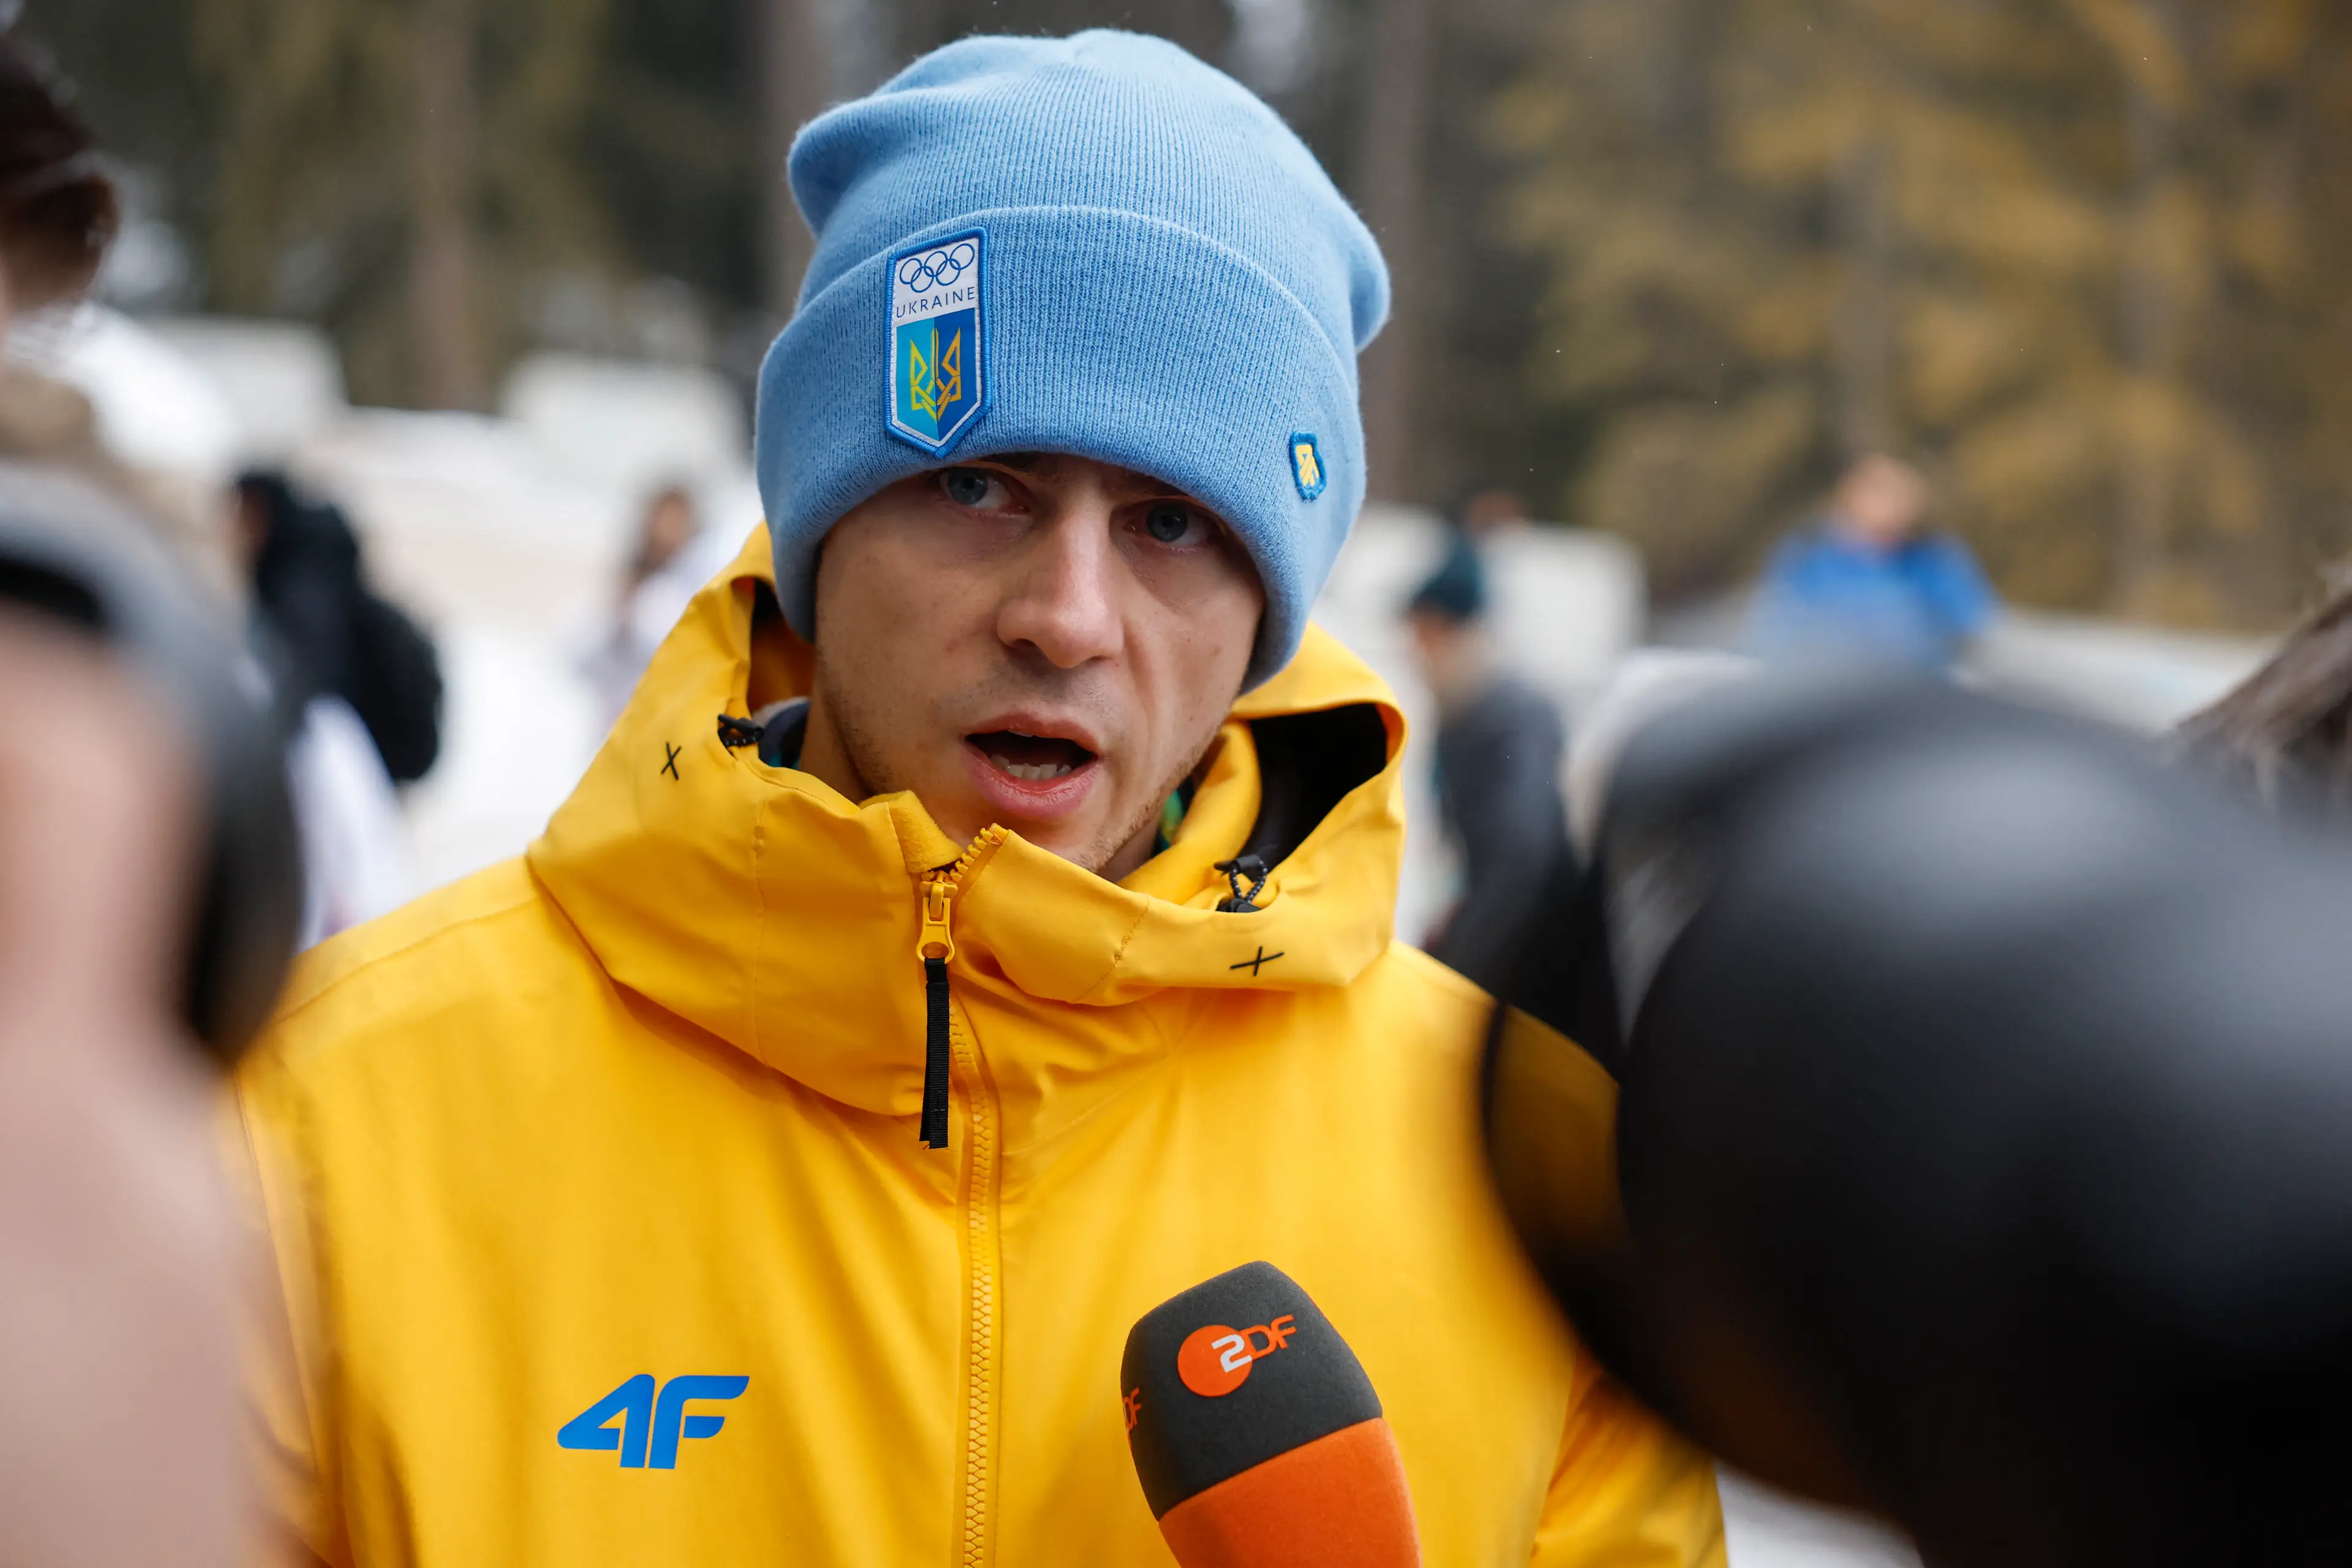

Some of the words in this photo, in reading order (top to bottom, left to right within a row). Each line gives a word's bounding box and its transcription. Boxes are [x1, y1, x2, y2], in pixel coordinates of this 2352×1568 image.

[896, 286, 975, 318] UKRAINE
[557, 1373, 750, 1469] 4F
[1122, 1387, 1142, 1432] DF
